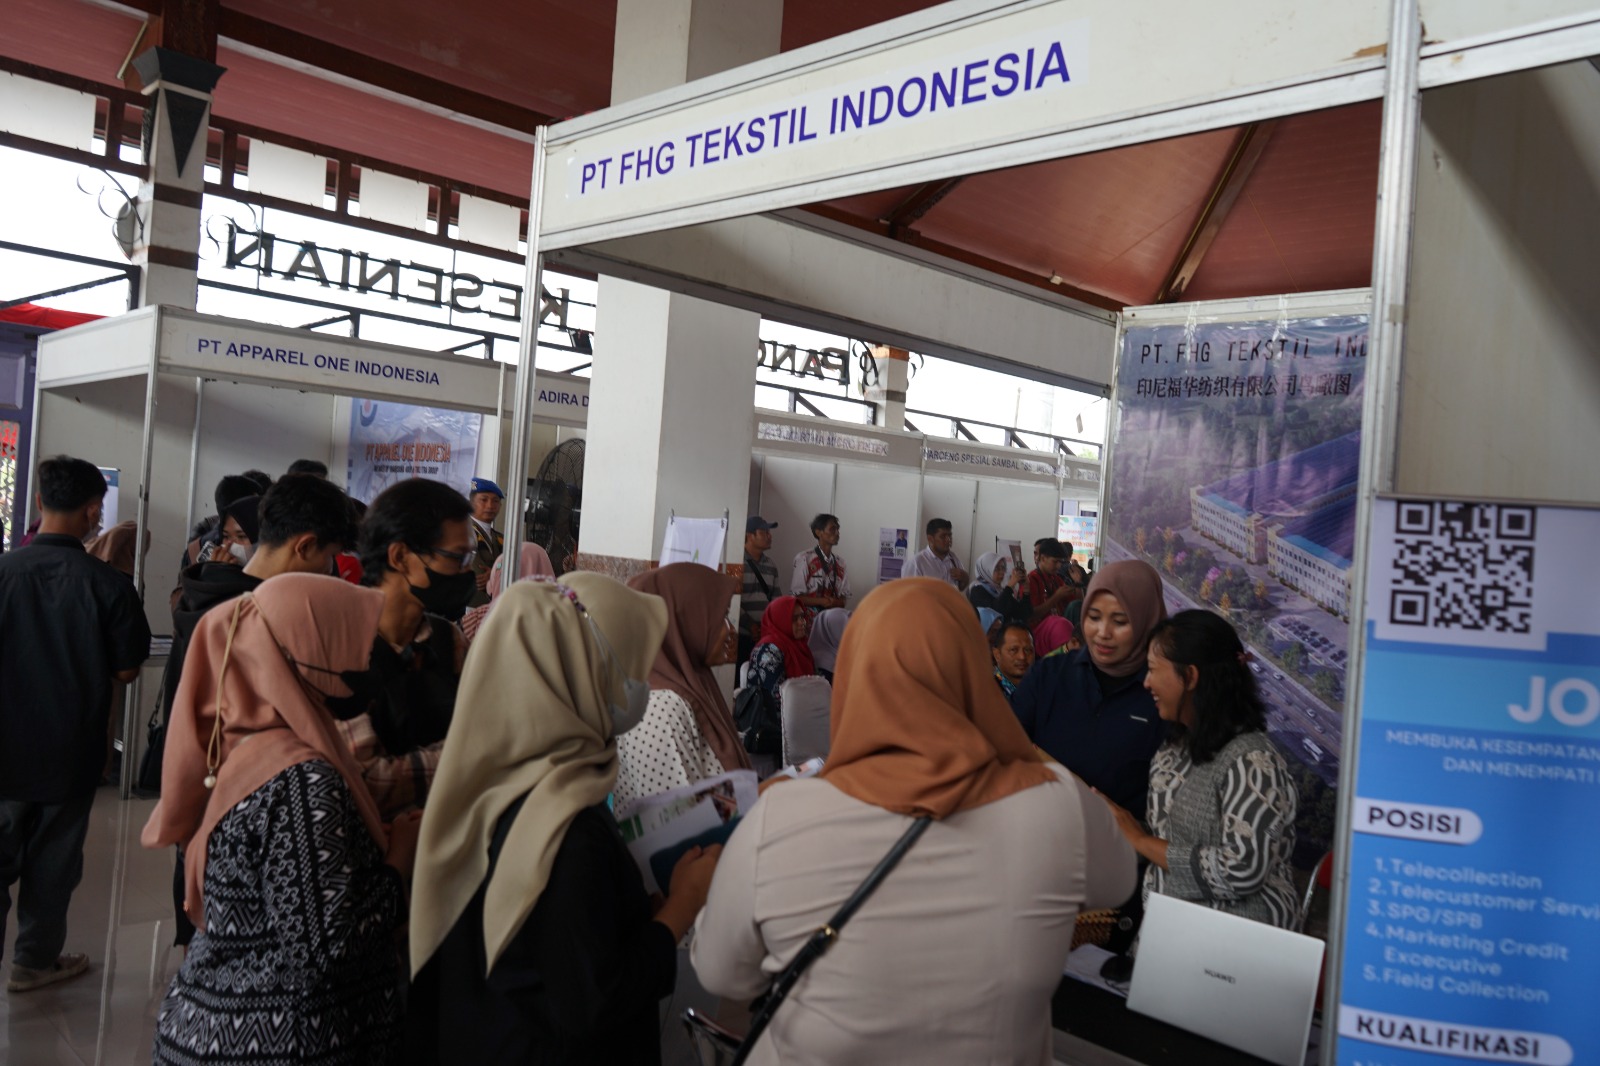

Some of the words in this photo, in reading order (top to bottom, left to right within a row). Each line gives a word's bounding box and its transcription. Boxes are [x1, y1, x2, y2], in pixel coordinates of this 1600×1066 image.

[581, 156, 613, 195] PT
[619, 140, 676, 186] FHG
[686, 105, 818, 168] TEKSTIL
[829, 40, 1072, 136] INDONESIA
[197, 338, 221, 355] PT
[226, 341, 309, 369] APPAREL
[314, 353, 350, 373] ONE
[354, 359, 440, 387] INDONESIA
[1227, 337, 1312, 362] TEKSTIL
[538, 390, 578, 406] ADIRA
[961, 453, 990, 466] SPESIAL
[992, 458, 1019, 470] SAMBAL
[1506, 675, 1600, 727] JO
[1386, 730, 1479, 751] MEMBUKA
[1481, 738, 1600, 762] KESEMPATAN
[1442, 756, 1483, 774] DAN
[1486, 761, 1595, 784] MENEMPATI
[1367, 806, 1462, 835] POSISI
[1390, 858, 1543, 890] Telecollection
[1389, 880, 1536, 912] Telecustomer
[1387, 902, 1483, 930] SPG/SPB
[1385, 925, 1495, 956] Marketing
[1499, 938, 1570, 962] Credit
[1204, 968, 1236, 985] HUAWEI
[1383, 968, 1434, 991] Field
[1438, 976, 1550, 1004] Collection
[1356, 1014, 1540, 1058] KUALIFIKASI
